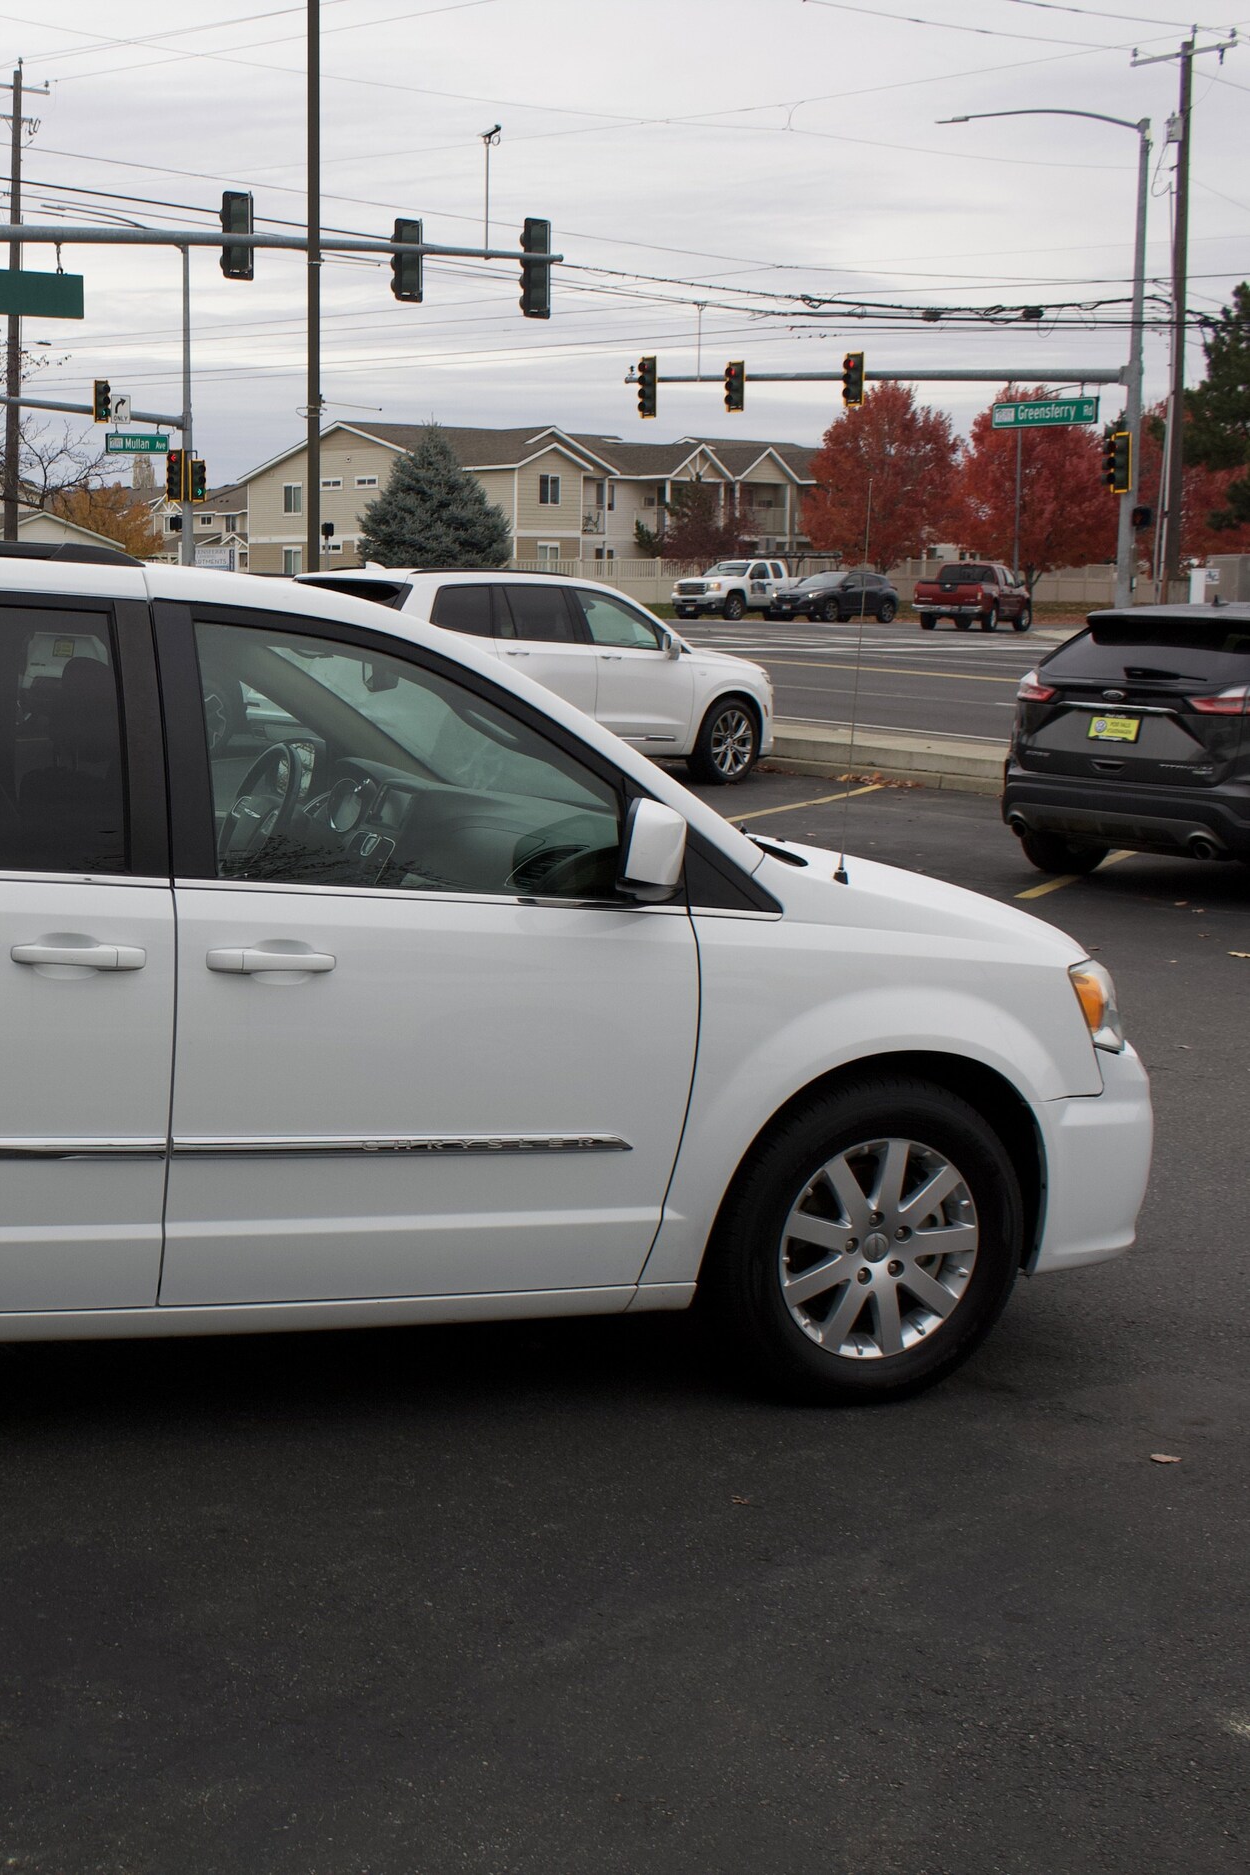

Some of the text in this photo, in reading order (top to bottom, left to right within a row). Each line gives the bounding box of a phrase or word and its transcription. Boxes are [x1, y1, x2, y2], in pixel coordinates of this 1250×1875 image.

[1017, 403, 1077, 420] Greensferry
[1083, 404, 1093, 417] Rd
[125, 438, 150, 450] Mullan
[155, 441, 166, 450] Ave
